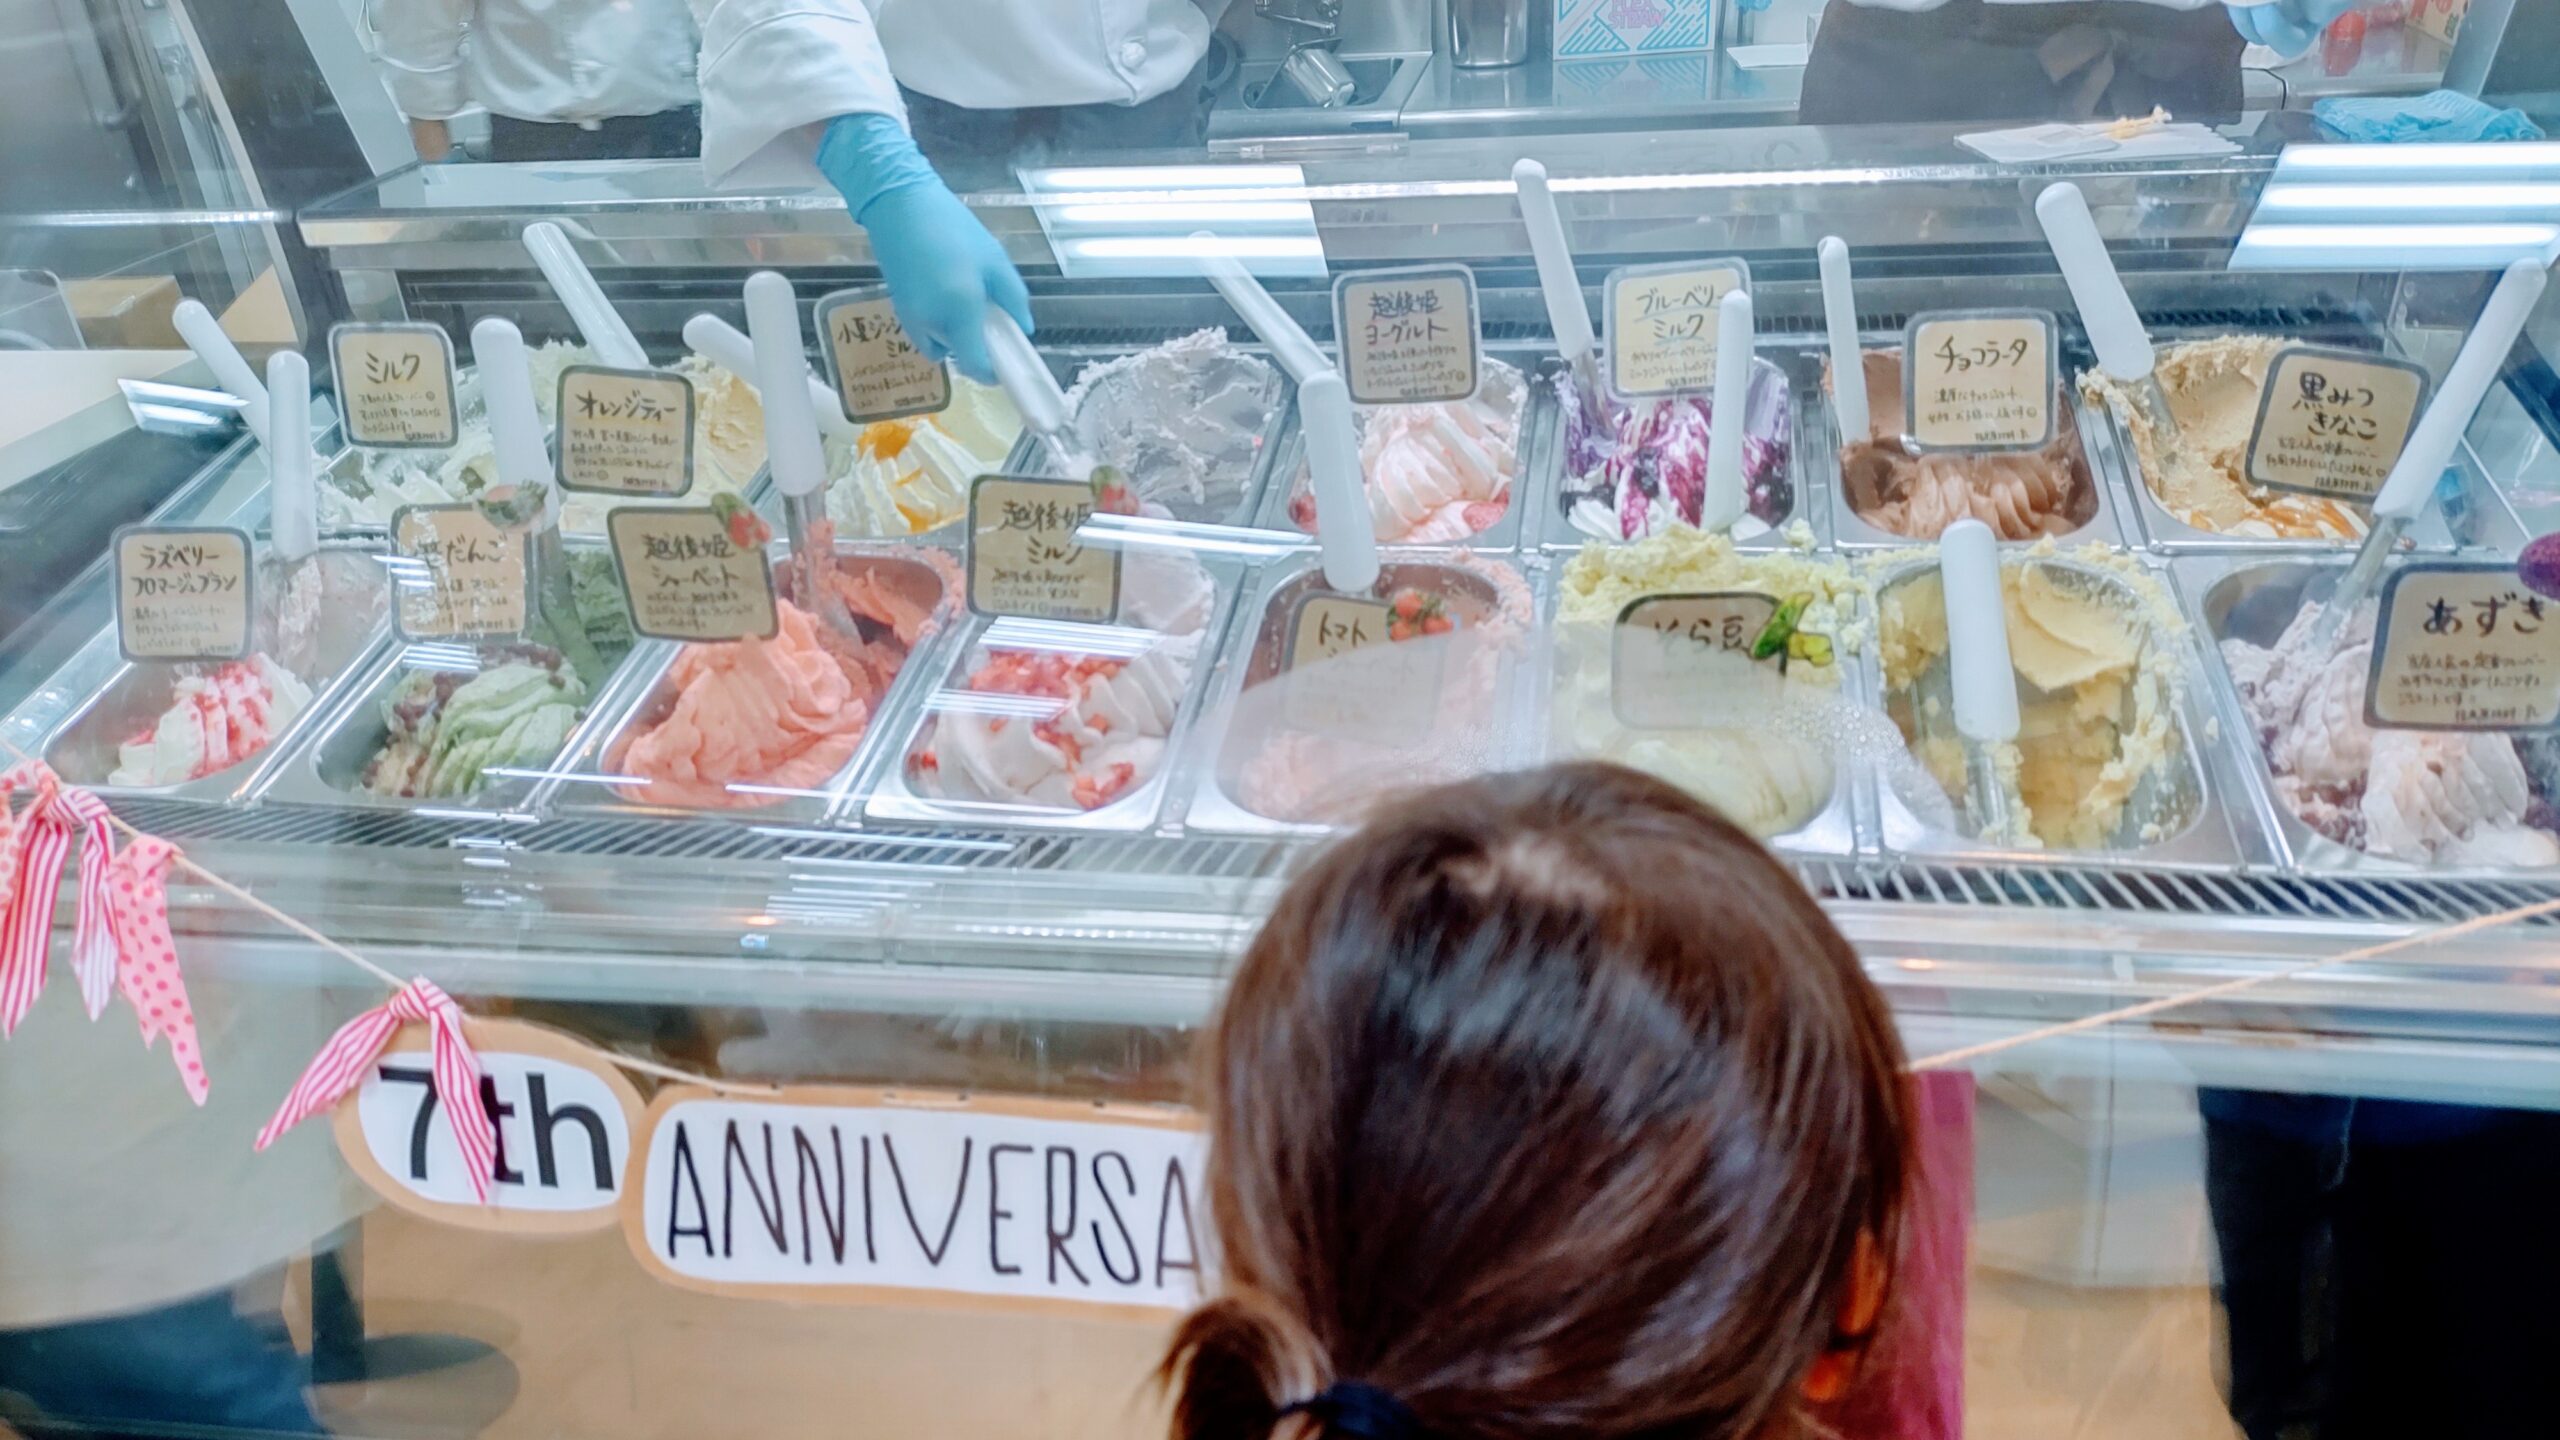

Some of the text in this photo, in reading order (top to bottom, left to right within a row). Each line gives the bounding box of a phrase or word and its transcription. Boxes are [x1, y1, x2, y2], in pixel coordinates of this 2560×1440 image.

[1364, 318, 1449, 345] ヨーグルト
[1653, 313, 1704, 339] ミルク
[886, 339, 920, 358] ミル
[1934, 335, 2028, 374] チョコラータ
[365, 351, 420, 384] ミルク
[575, 389, 676, 422] オレンジティー
[2292, 371, 2374, 410] 黒みつ
[2307, 411, 2378, 441] きなこ
[139, 543, 221, 570] ラズベリー
[1318, 611, 1369, 647] トマト
[2423, 591, 2545, 638] あずき
[377, 1065, 615, 1191] 7th
